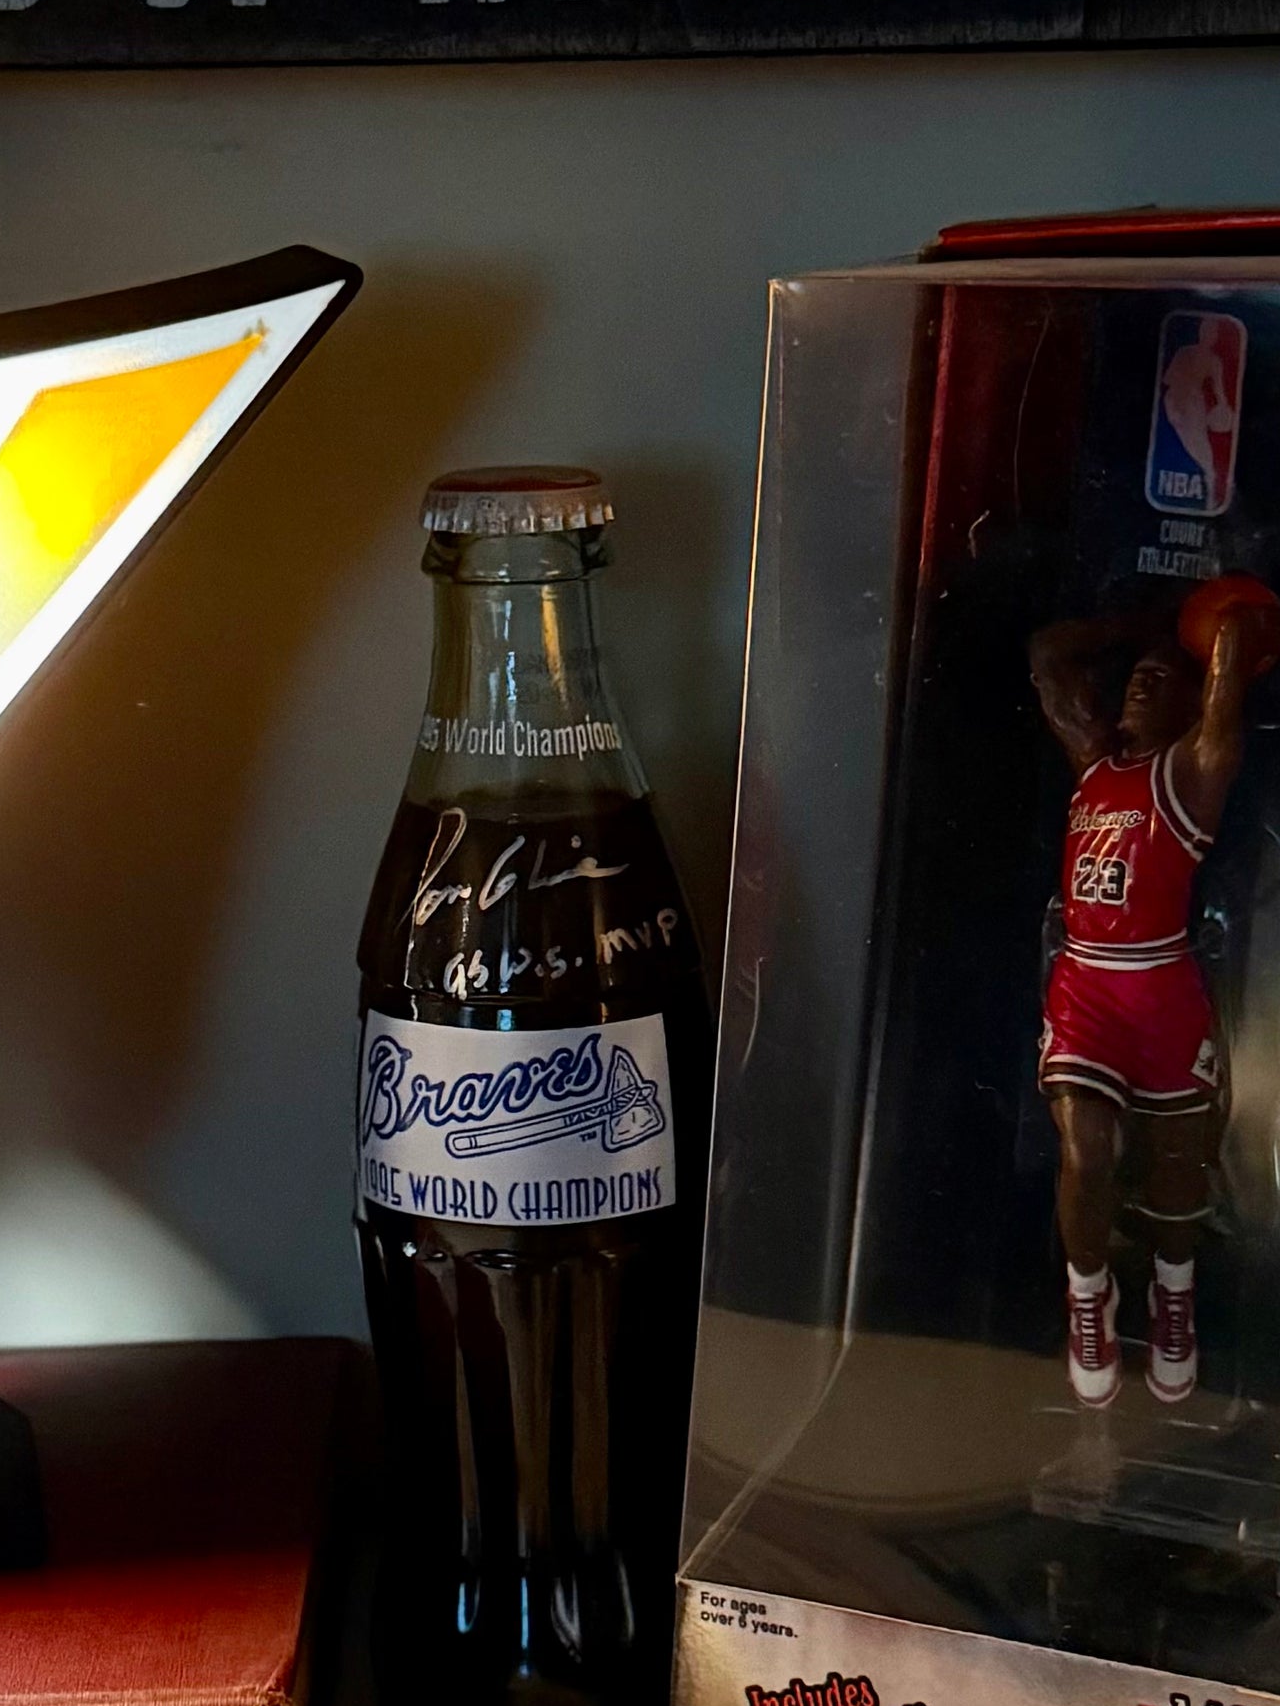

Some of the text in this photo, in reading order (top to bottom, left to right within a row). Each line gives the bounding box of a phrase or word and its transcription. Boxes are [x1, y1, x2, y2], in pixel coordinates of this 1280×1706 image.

[1157, 468, 1204, 501] NBA
[445, 718, 506, 756] World
[1072, 855, 1128, 905] 23
[364, 1033, 602, 1143] Braves
[409, 1172, 498, 1219] WORLD
[508, 1165, 662, 1221] CHAMPIONS
[701, 1591, 767, 1615] For ages
[700, 1610, 734, 1626] over
[751, 1619, 799, 1639] years.
